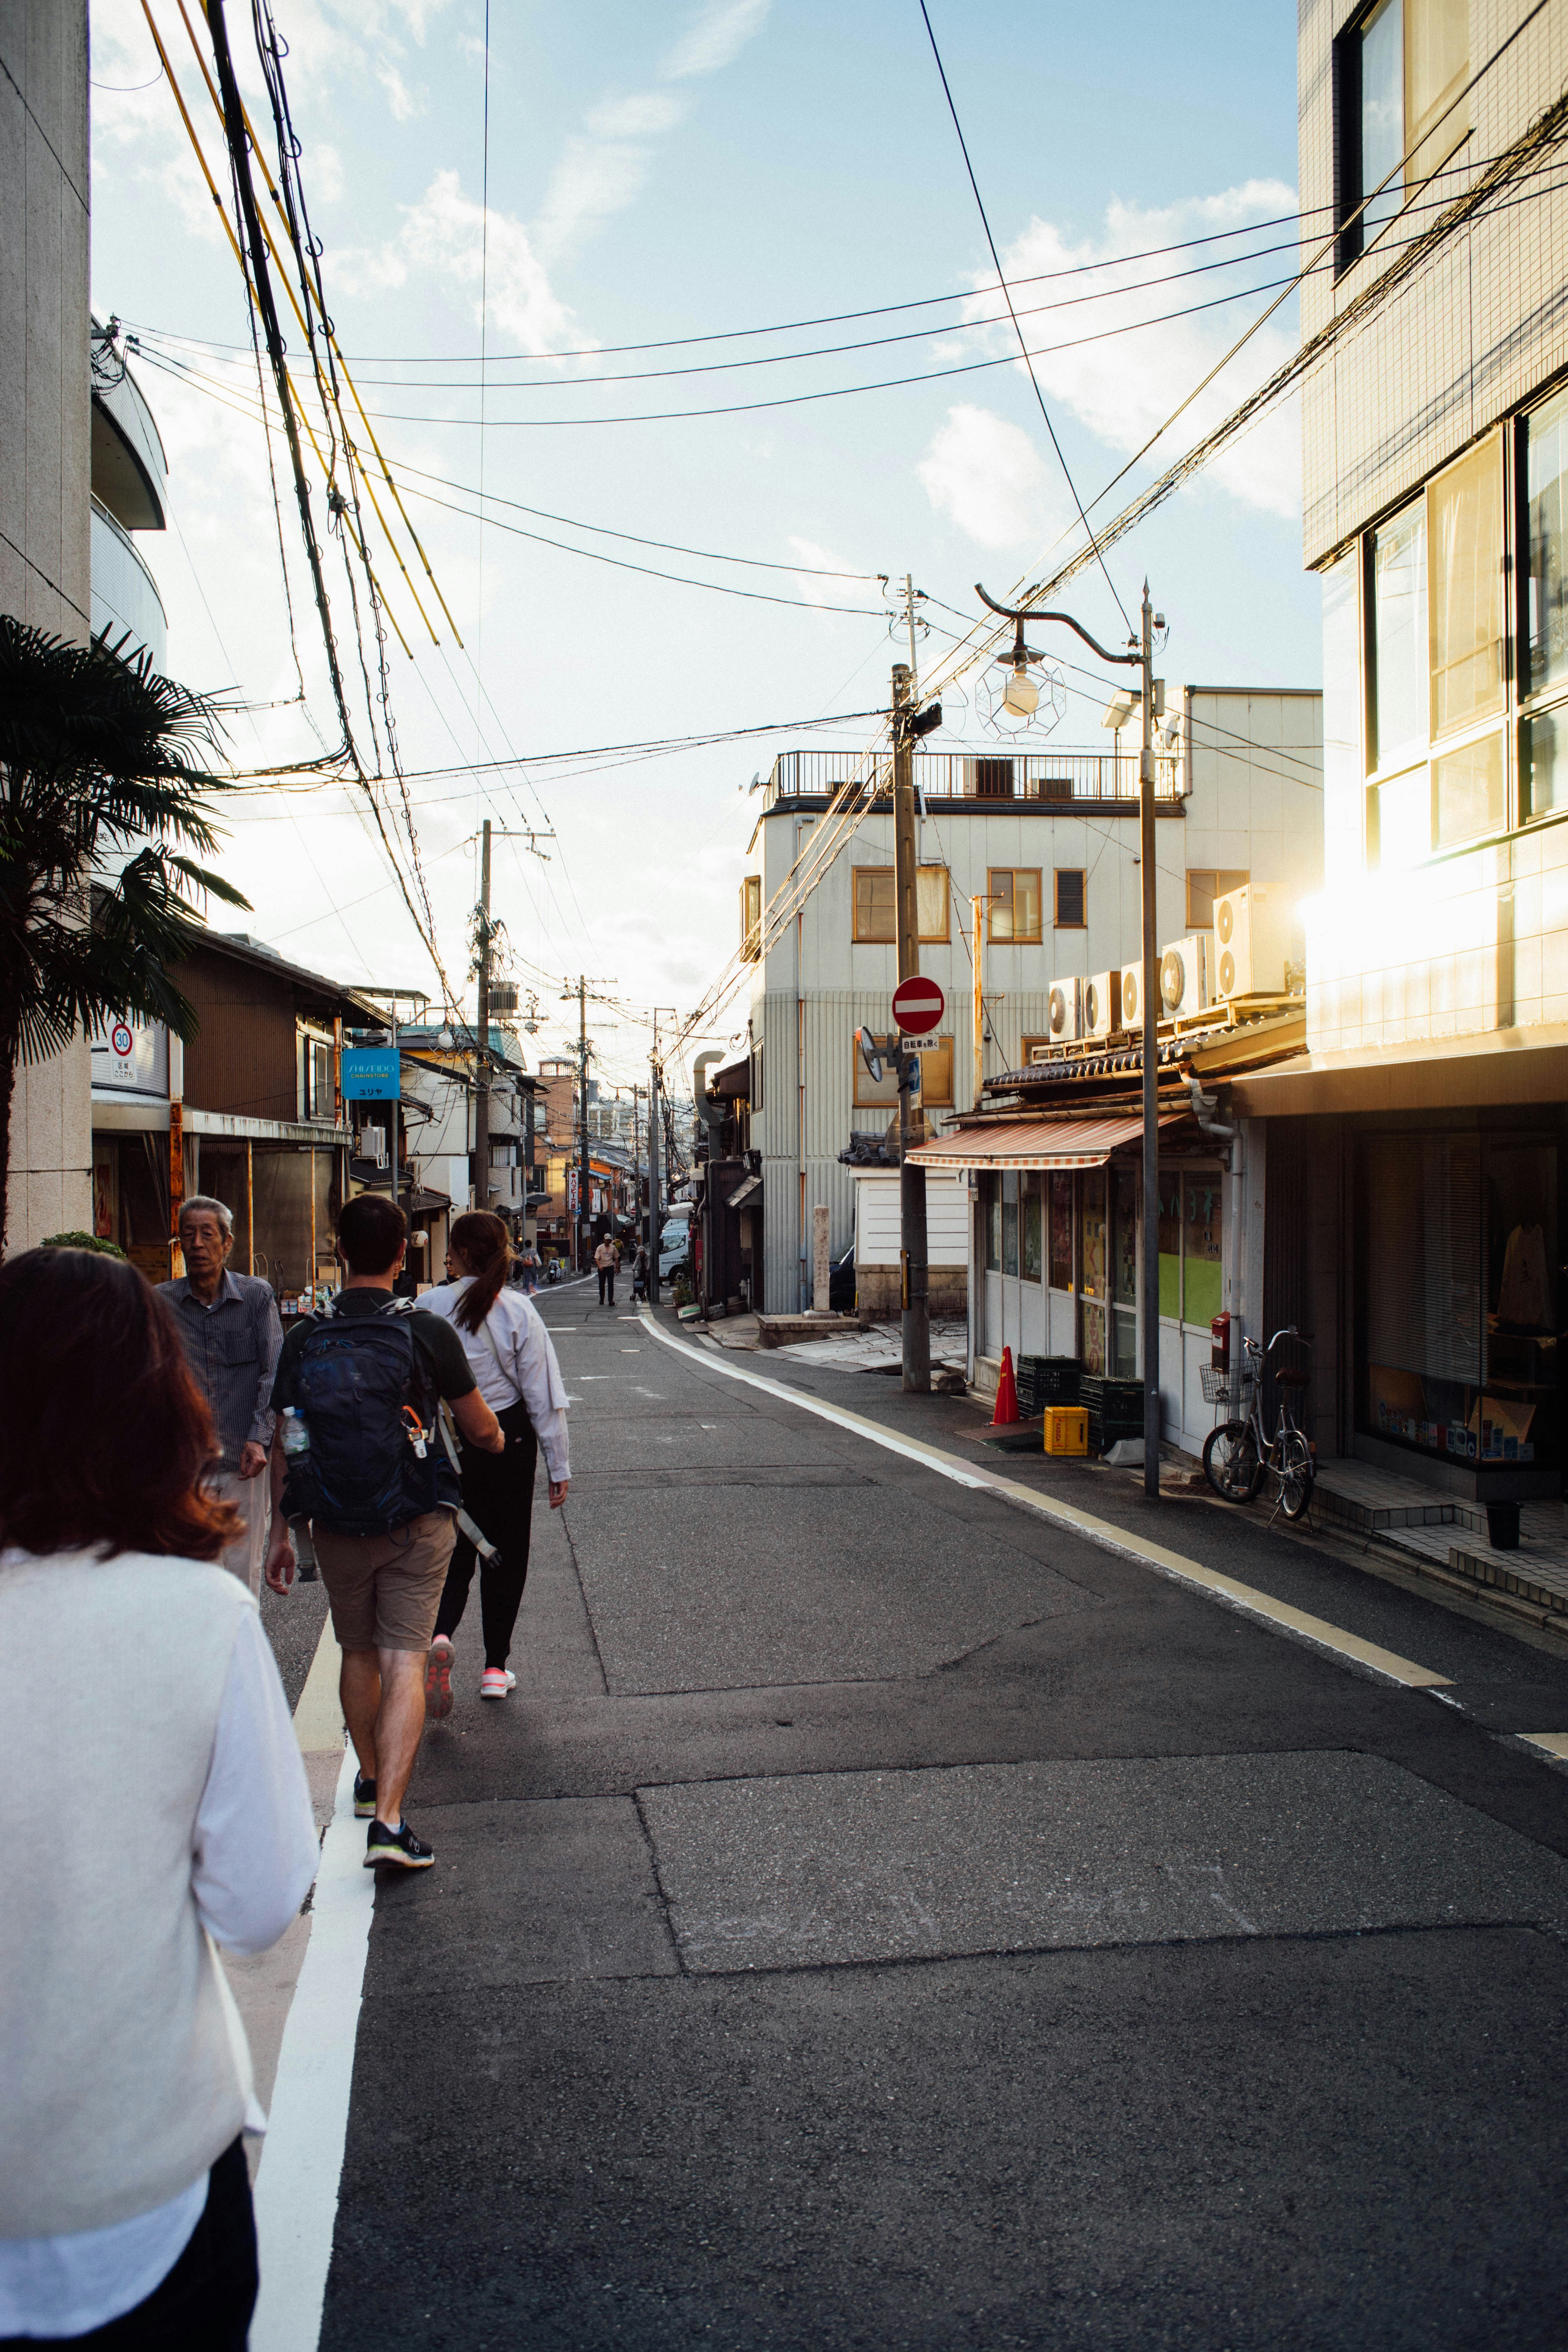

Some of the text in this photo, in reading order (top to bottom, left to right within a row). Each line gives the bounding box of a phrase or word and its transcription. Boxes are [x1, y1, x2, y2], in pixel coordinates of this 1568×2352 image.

[116, 1033, 128, 1047] 30
[904, 1039, 937, 1049] 自転車を除く
[346, 1064, 394, 1073] SHISEIDO
